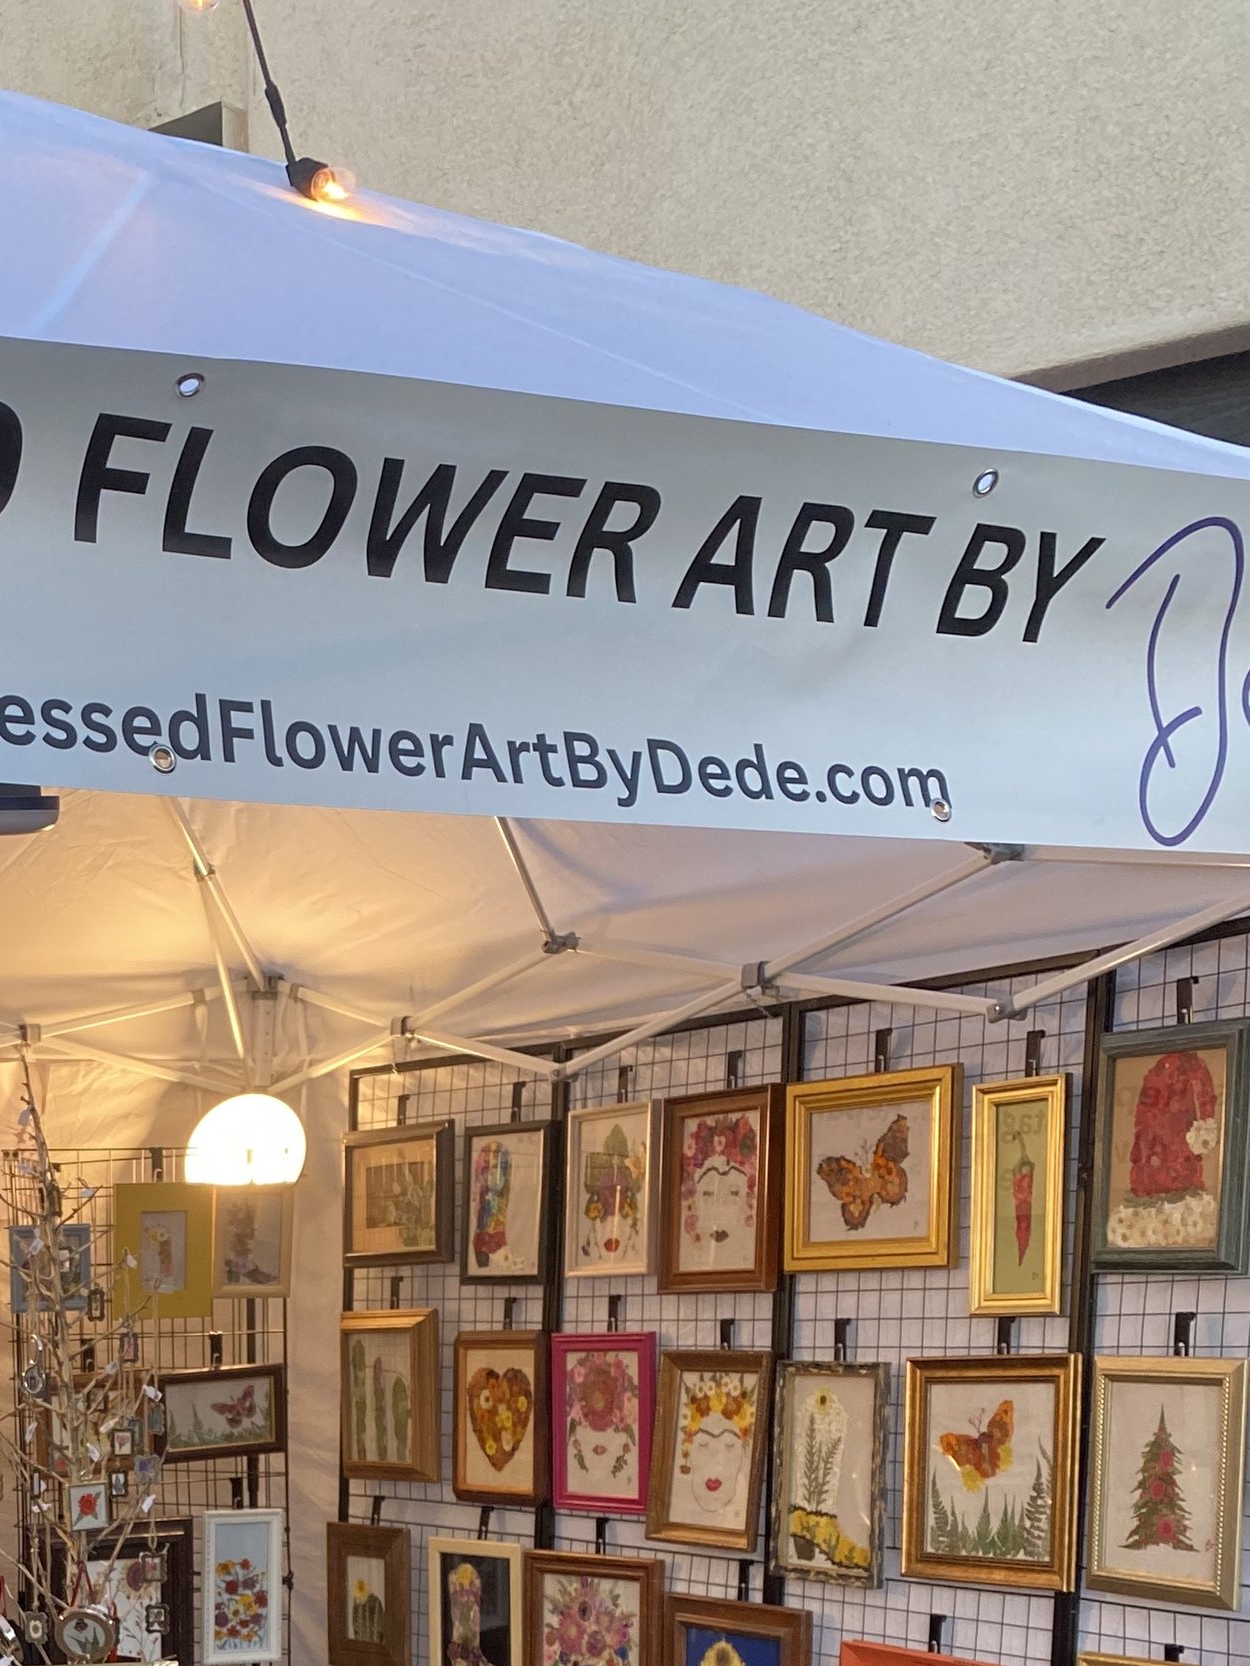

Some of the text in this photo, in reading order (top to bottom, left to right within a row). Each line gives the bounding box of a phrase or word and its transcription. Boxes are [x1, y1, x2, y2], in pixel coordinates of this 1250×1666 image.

[74, 412, 661, 604] FLOWER
[671, 495, 937, 628] ART
[935, 523, 1106, 643] BY
